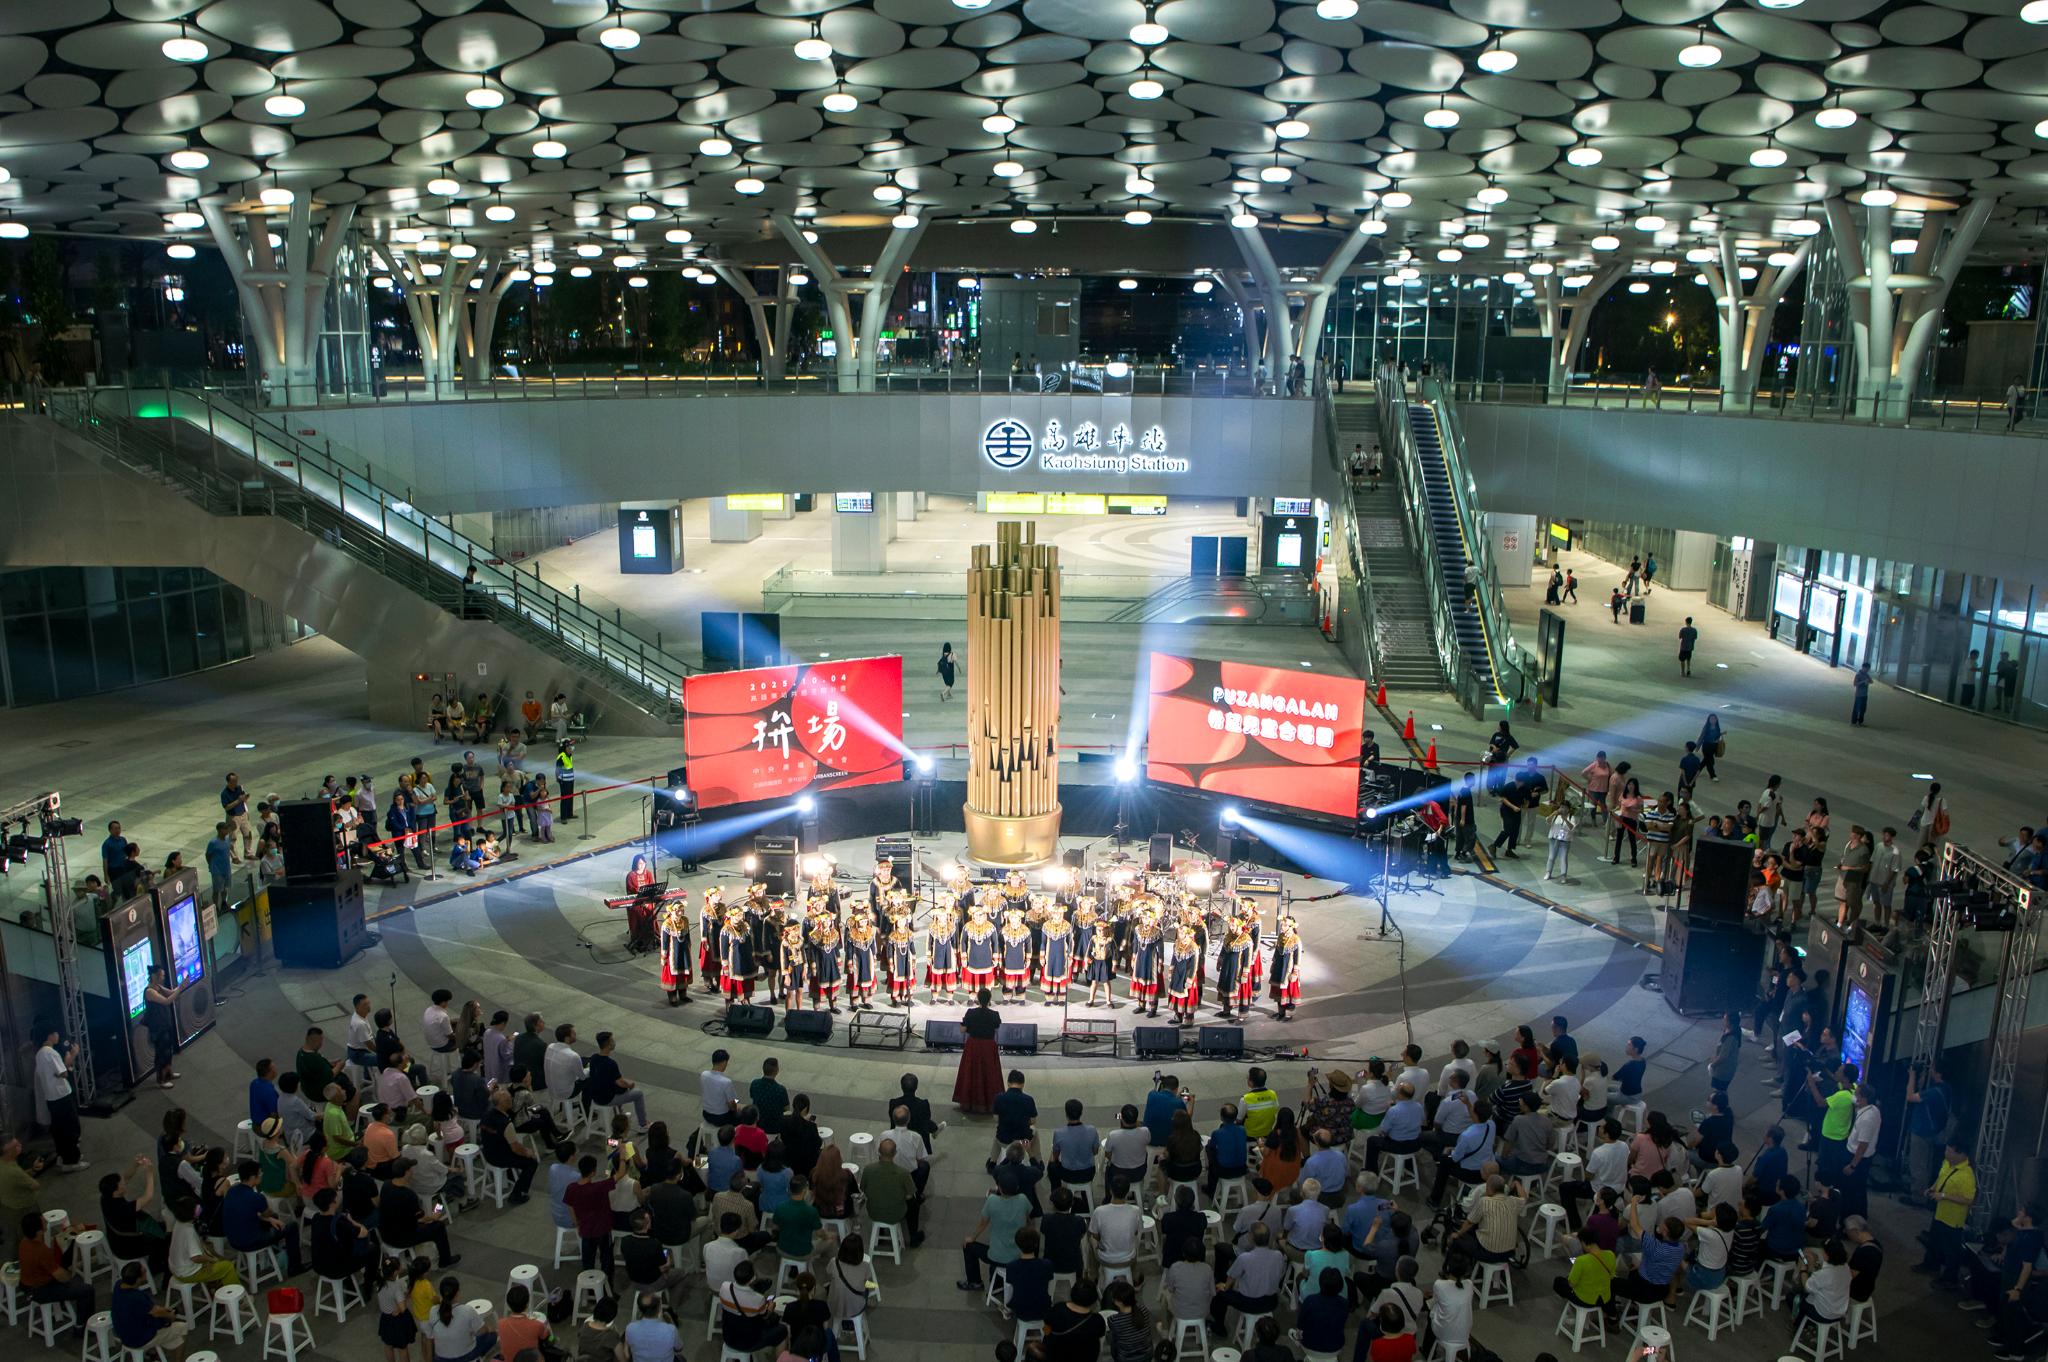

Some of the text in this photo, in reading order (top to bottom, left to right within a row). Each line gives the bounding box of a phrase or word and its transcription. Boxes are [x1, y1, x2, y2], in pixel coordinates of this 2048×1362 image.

[1043, 421, 1166, 453] 高雄車站
[1043, 456, 1186, 473] Kaohsiung Station
[750, 673, 847, 691] 2025.10.04
[1212, 686, 1339, 721] PUZANGALAN
